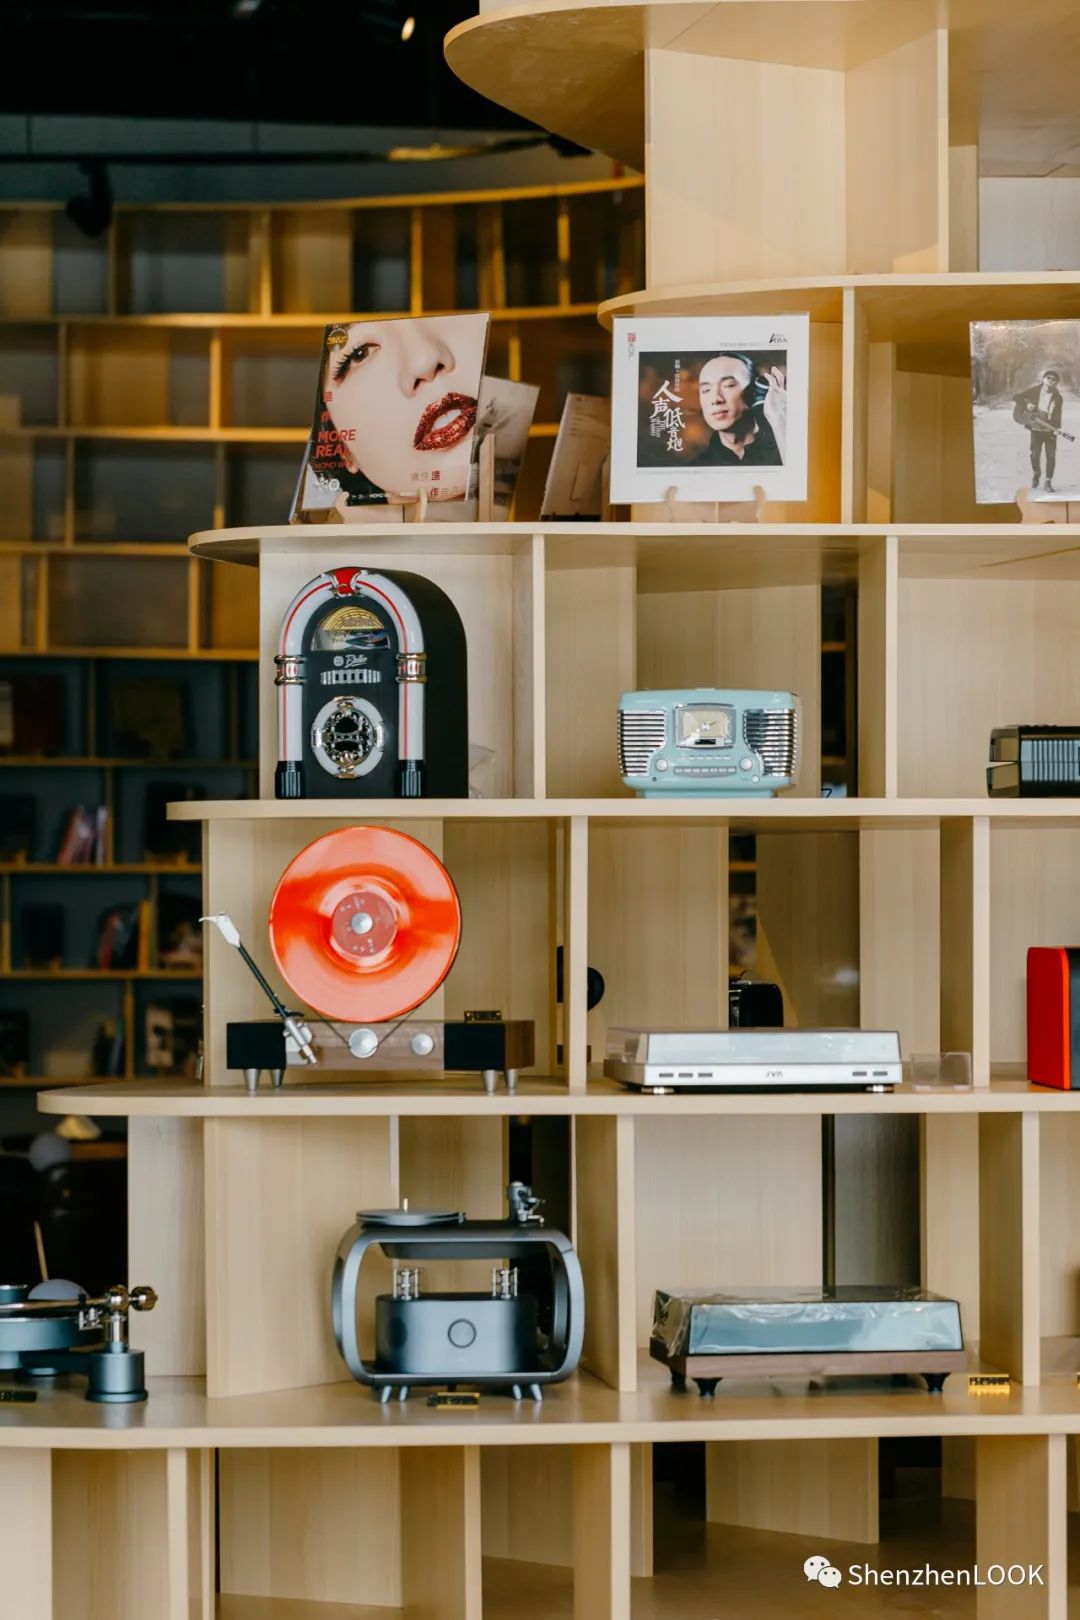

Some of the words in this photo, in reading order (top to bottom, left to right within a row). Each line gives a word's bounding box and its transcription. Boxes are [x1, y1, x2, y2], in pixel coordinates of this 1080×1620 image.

[317, 429, 357, 443] MORE
[650, 380, 686, 452] 人声低音炮
